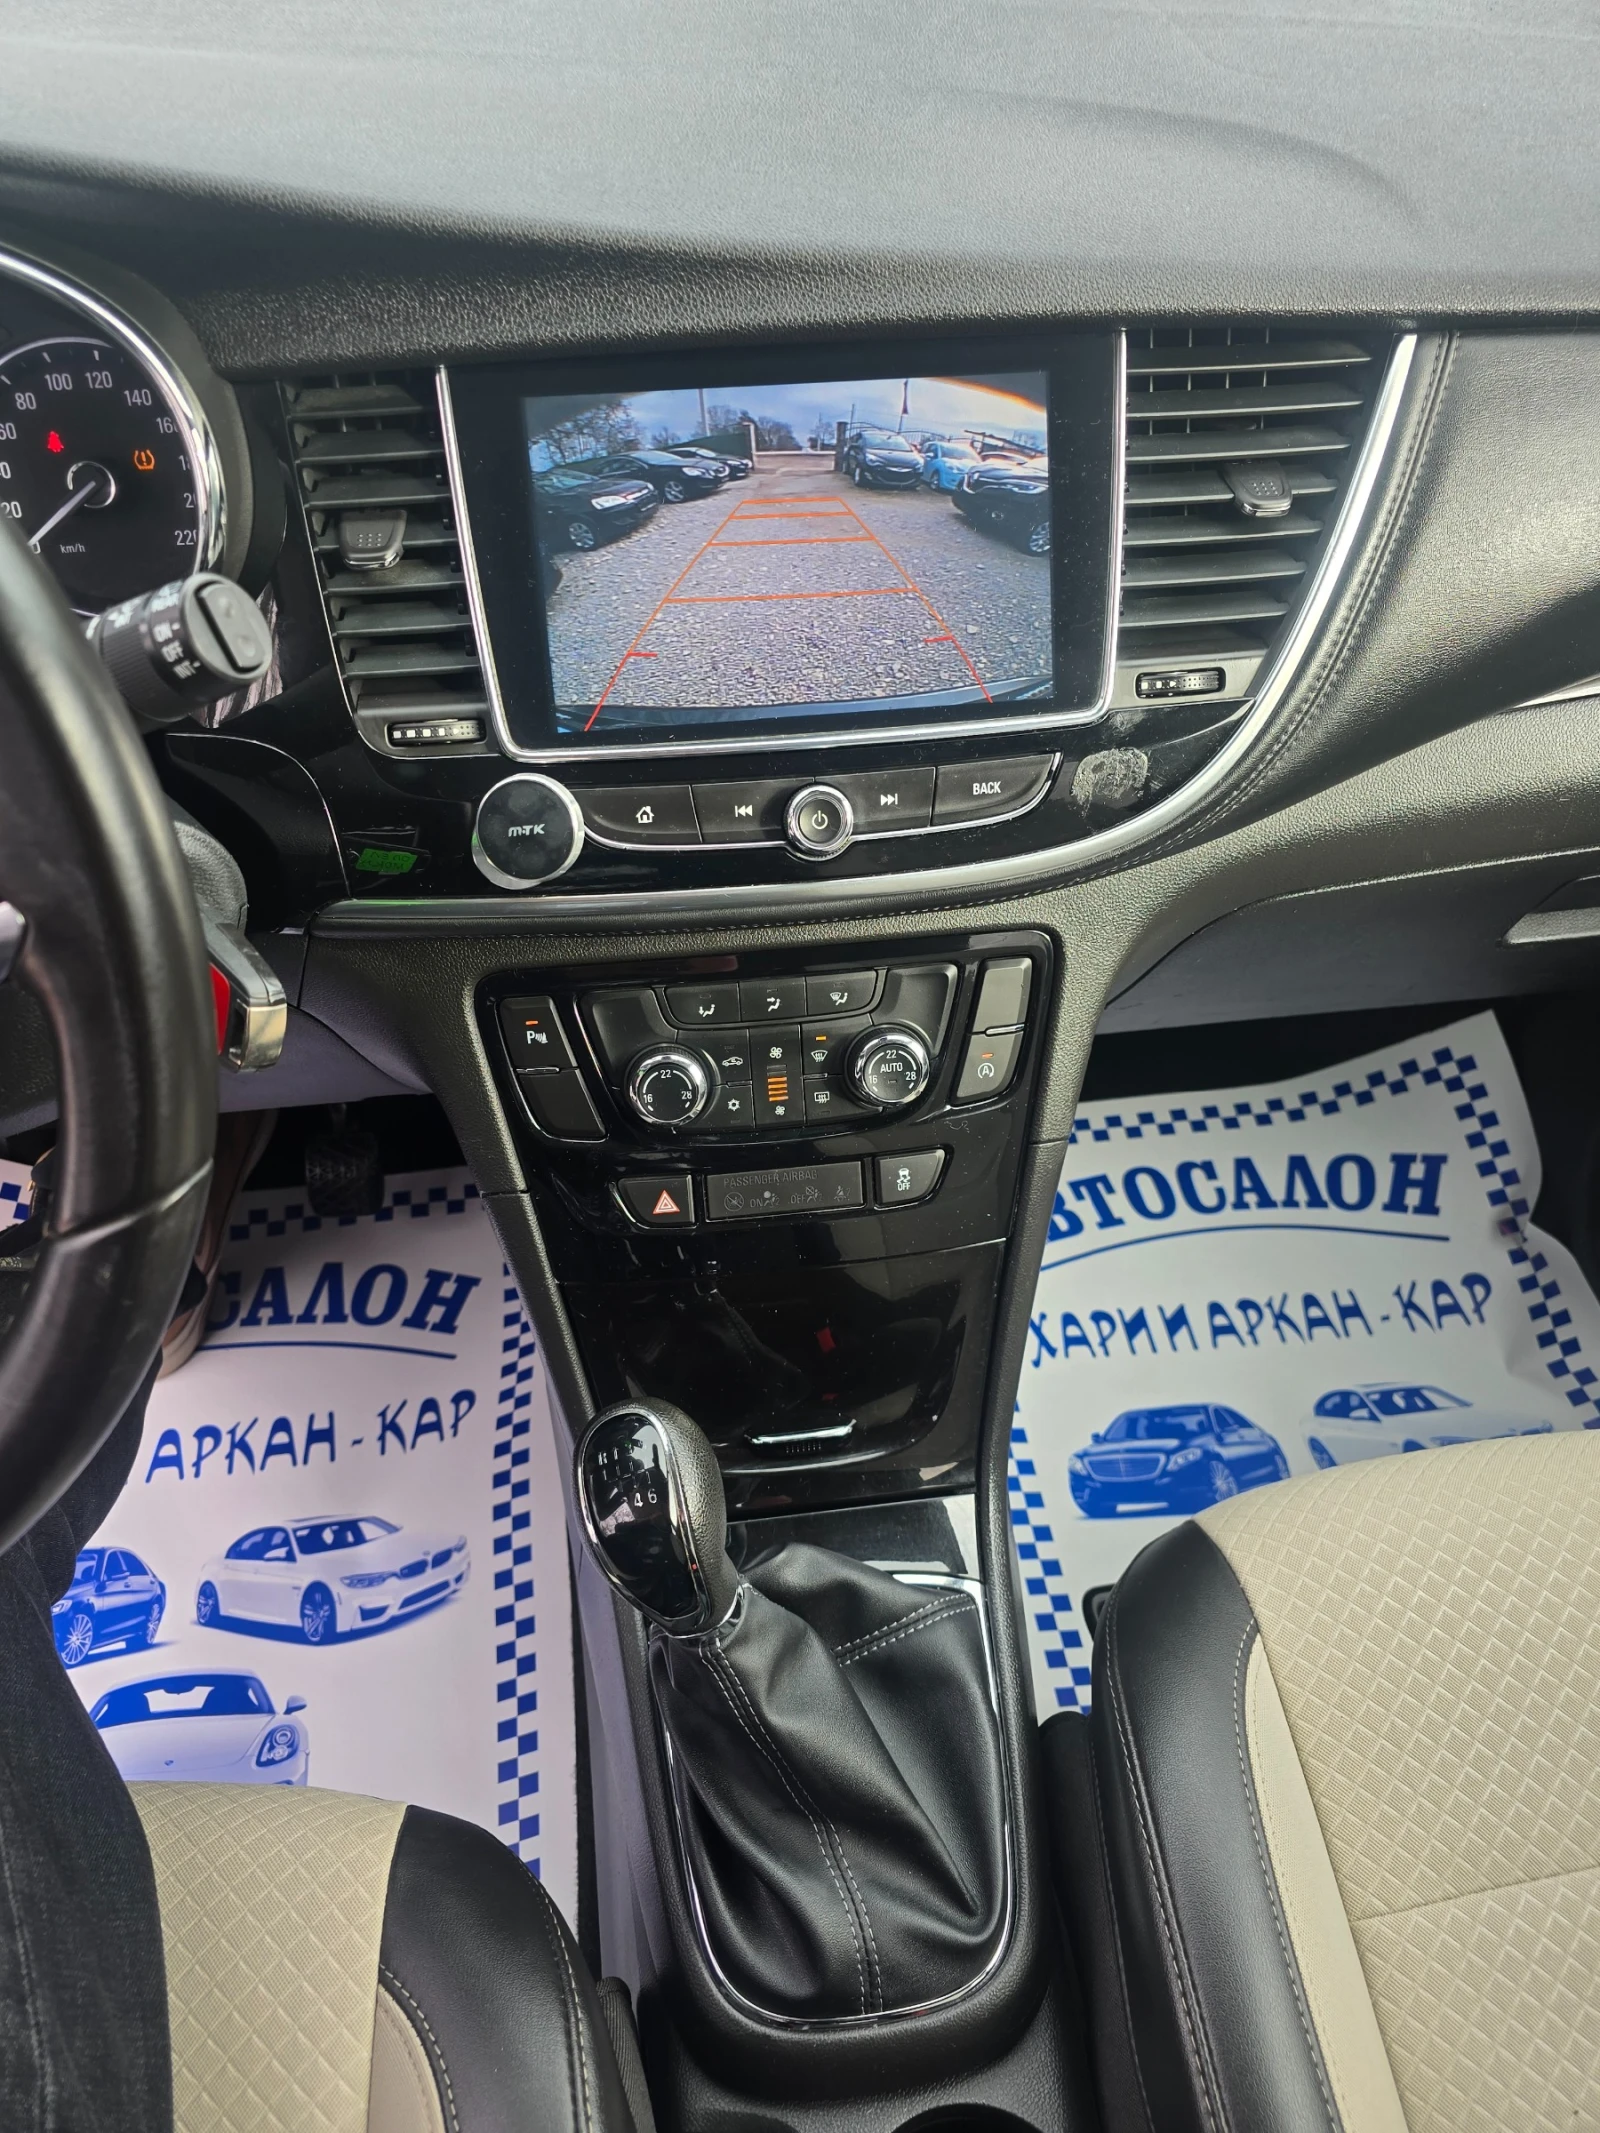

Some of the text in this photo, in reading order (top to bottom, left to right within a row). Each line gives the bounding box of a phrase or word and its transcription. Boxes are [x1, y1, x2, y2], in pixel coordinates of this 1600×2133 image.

[44, 373, 73, 391] 100
[85, 371, 113, 389] 120
[14, 392, 37, 410] 80
[123, 389, 152, 407] 140
[0, 461, 12, 479] 0
[60, 543, 86, 554] km/h
[972, 781, 1002, 796] BACK
[886, 1050, 897, 1060] 22
[660, 1069, 672, 1079] 22
[880, 1062, 904, 1074] AUTO
[868, 1075, 878, 1085] 16
[905, 1071, 917, 1082] 28
[643, 1094, 653, 1104] 16
[681, 1090, 693, 1101] 28
[723, 1169, 818, 1188] PASSENGER AIRBAG
[897, 1182, 911, 1192] OFF
[1046, 1153, 1449, 1243] ВТОСАЛОН
[647, 1487, 658, 1504] 6
